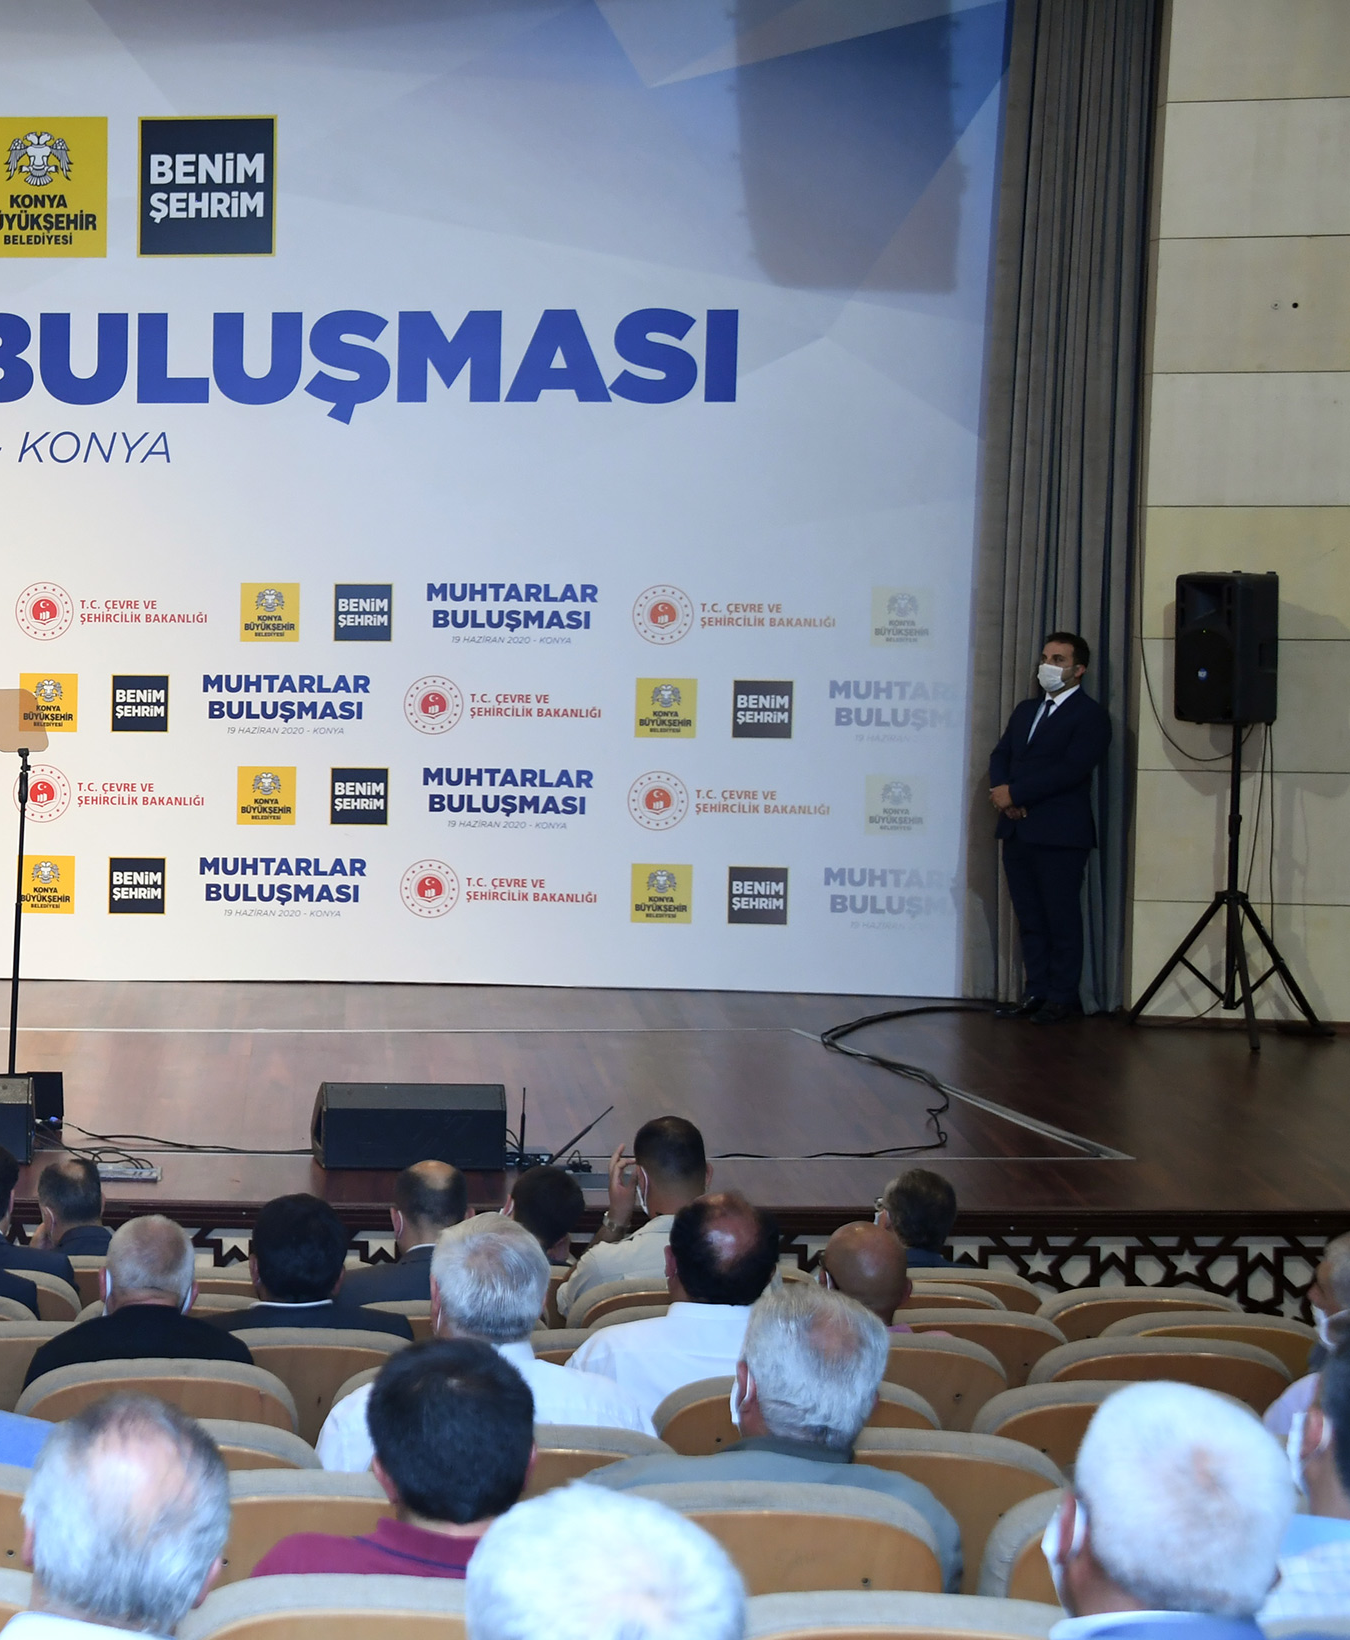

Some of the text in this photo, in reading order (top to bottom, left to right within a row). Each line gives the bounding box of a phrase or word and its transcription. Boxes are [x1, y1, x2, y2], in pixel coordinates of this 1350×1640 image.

[9, 195, 67, 209] KONYA
[3, 233, 73, 246] BELEDİYESİ
[18, 431, 170, 463] KONYA
[427, 583, 598, 603] MUHTARLAR
[80, 600, 157, 612] T.C. ÇEVRE VE
[80, 612, 207, 625] ŞEHİRCİLİK BAKANLIĞI
[432, 609, 590, 631] BULUŞMASI
[701, 616, 835, 628] ŞEHİRCİLİK BAKANLIĞI
[202, 675, 370, 693] MUHTARLAR
[470, 694, 549, 706] T.C. ÇEVRE VE
[209, 700, 363, 720] BULUŞMASI
[470, 706, 601, 719] ŞEHİRCİLİK BAKANLIĞI
[423, 768, 593, 789] MUHTARLAR
[78, 783, 153, 795] T.C. ÇEVRE VE
[78, 794, 204, 807] ŞEHİRCİLİK BAKANLIĞI
[429, 794, 586, 817] BULUŞMASI
[696, 802, 830, 815] ŞEHİRCİLİK BAKANLIĞI
[199, 858, 366, 877] MUHTARLAR
[33, 886, 58, 894] KONYA
[466, 878, 545, 890] T.C. ÇEVRE VE
[205, 883, 359, 903] BULUŞMASI
[466, 890, 597, 903] ŞEHİRCİLİK BAKANLIĞI
